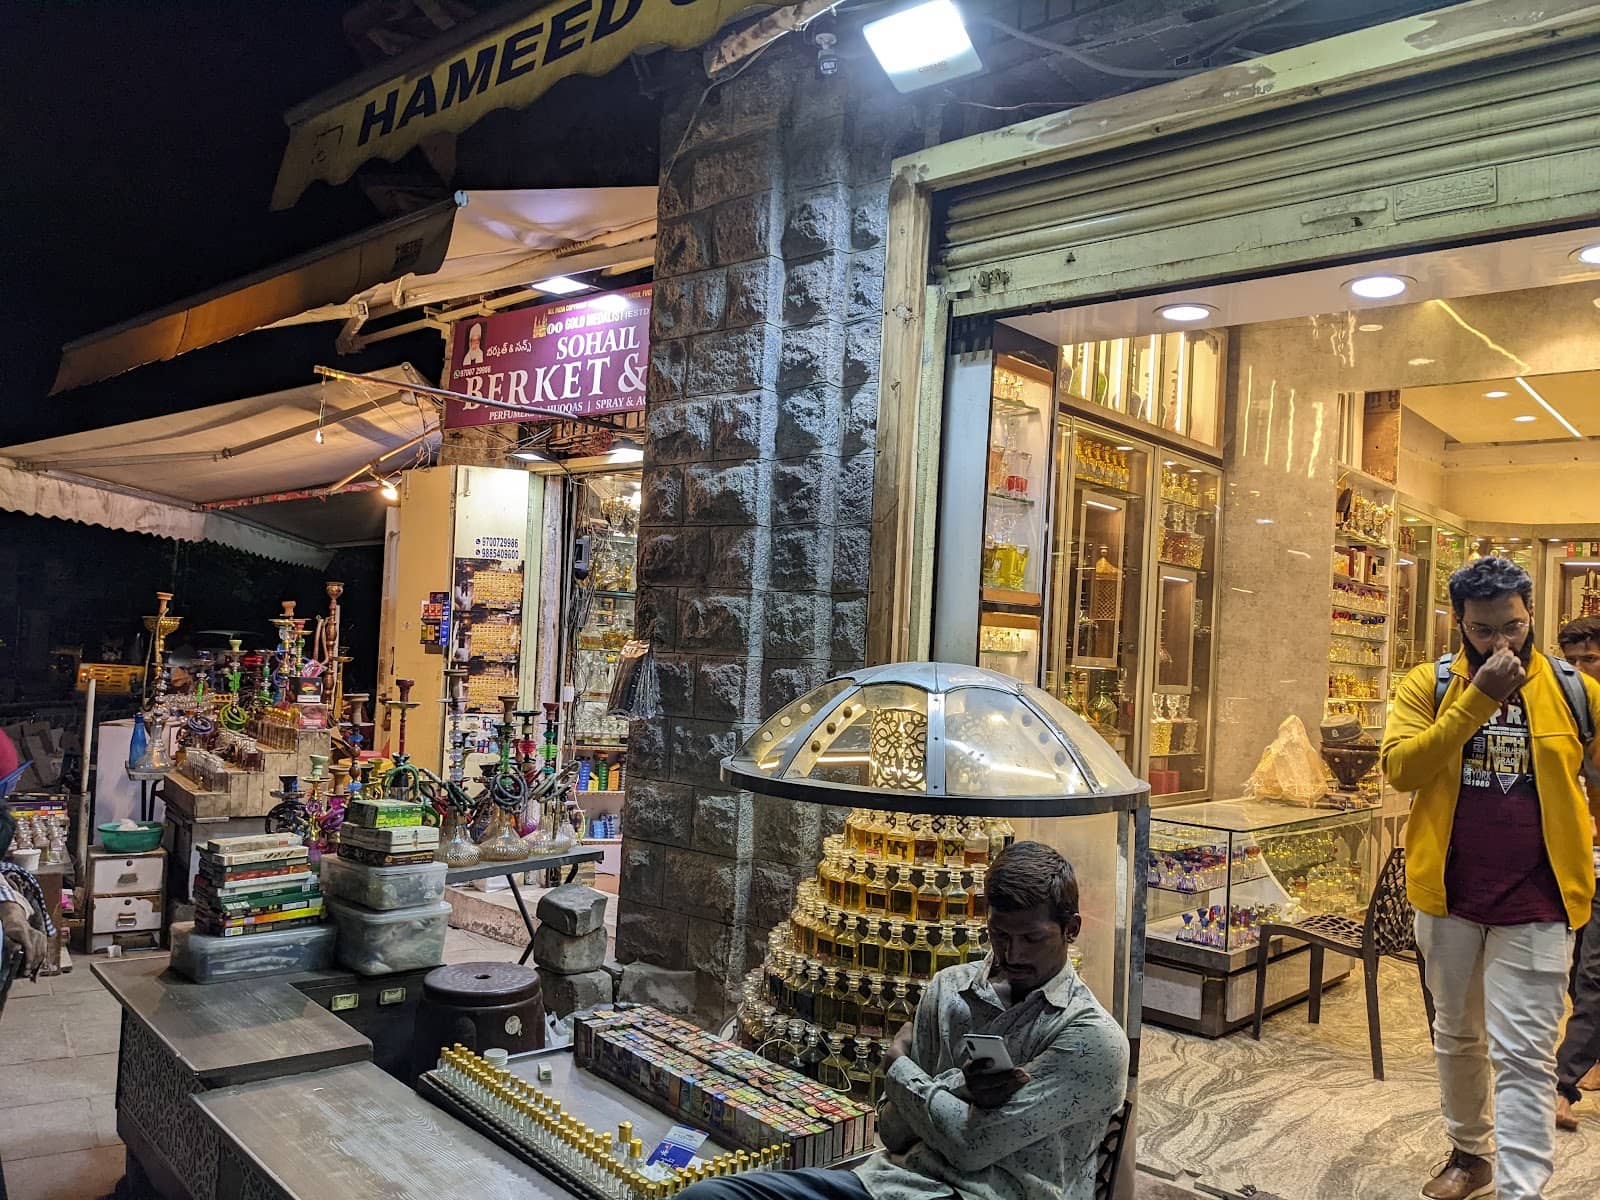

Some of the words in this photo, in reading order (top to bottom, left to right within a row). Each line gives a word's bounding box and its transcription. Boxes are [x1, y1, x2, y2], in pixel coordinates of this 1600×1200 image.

[358, 0, 643, 147] HAMEED
[556, 326, 640, 360] SOHAIL
[463, 356, 611, 411] BERKET
[618, 353, 648, 393] &
[595, 398, 625, 410] SPRAY
[626, 397, 633, 407] &
